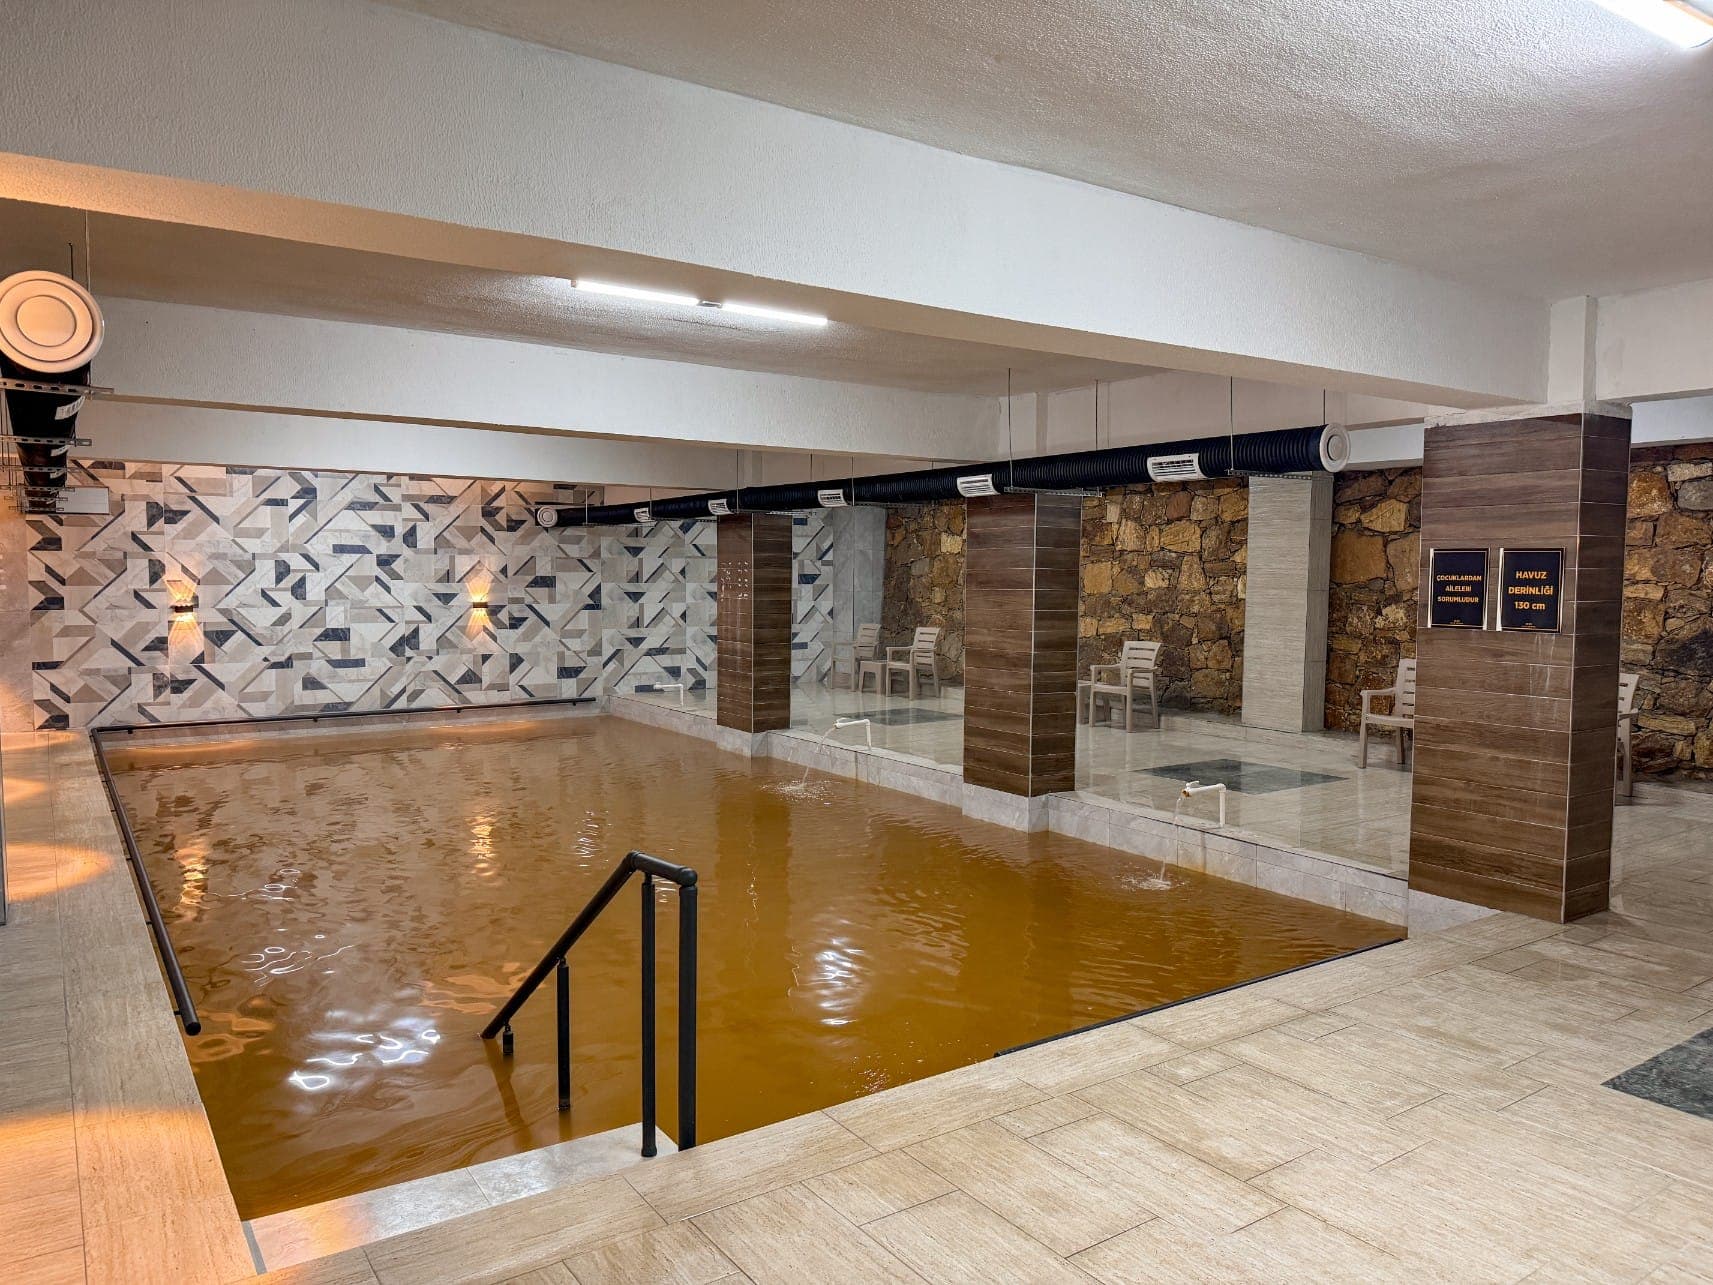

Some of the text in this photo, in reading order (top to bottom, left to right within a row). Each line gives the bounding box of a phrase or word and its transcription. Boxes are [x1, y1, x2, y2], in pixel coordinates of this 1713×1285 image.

[1515, 570, 1547, 579] HAVUZ
[1508, 585, 1554, 595] DERİNLİĞİ
[1514, 601, 1546, 610] 130 cm
